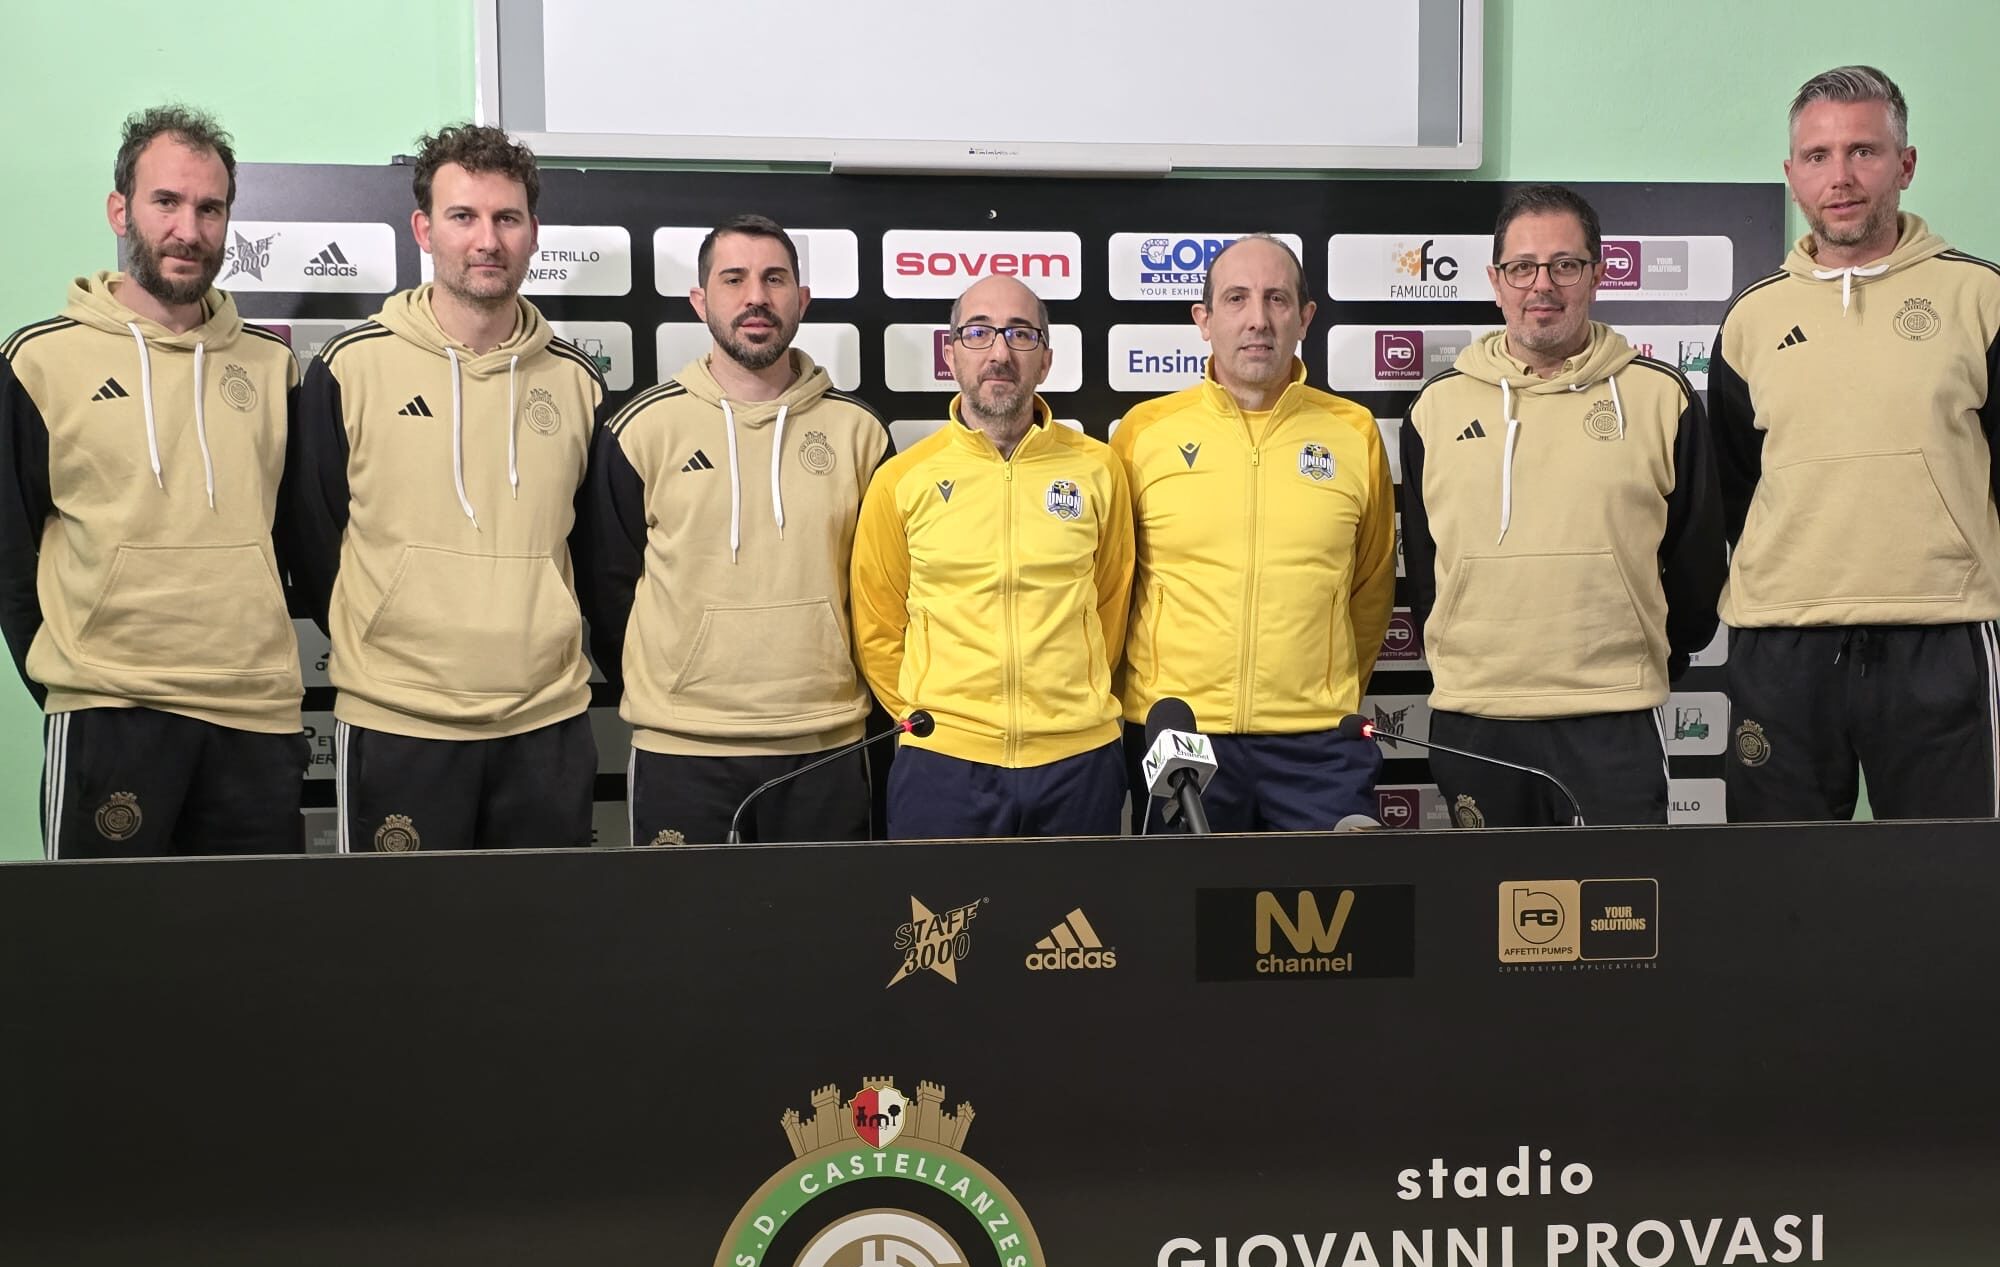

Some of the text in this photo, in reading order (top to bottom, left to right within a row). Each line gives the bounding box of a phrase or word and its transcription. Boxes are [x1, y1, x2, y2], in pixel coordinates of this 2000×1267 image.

[225, 234, 275, 260] STAFF
[541, 251, 600, 262] ETRILLO
[304, 263, 357, 276] adidas
[896, 252, 1070, 277] sovem
[1421, 240, 1458, 281] fc
[1647, 265, 1681, 273] SOLUTIONS
[529, 269, 567, 280] NERS
[1140, 288, 1167, 296] YOUR
[1390, 285, 1458, 298] FAMUCOLOR
[1300, 453, 1334, 475] UNION
[1048, 491, 1081, 513] UNION
[1605, 906, 1632, 918] YOUR
[894, 899, 981, 950] STAFF
[1590, 918, 1646, 932] SOLUTIONS
[904, 933, 970, 975] 3000
[1025, 948, 1117, 971] adidas
[1504, 947, 1573, 956] AFFETTI PUMPS
[1256, 953, 1352, 973] channel
[1499, 962, 1657, 973] CORROSIVE APPLICATIONS
[1397, 1145, 1593, 1200] stadio
[1157, 1214, 1824, 1267] GIOVANNI PROVASI
